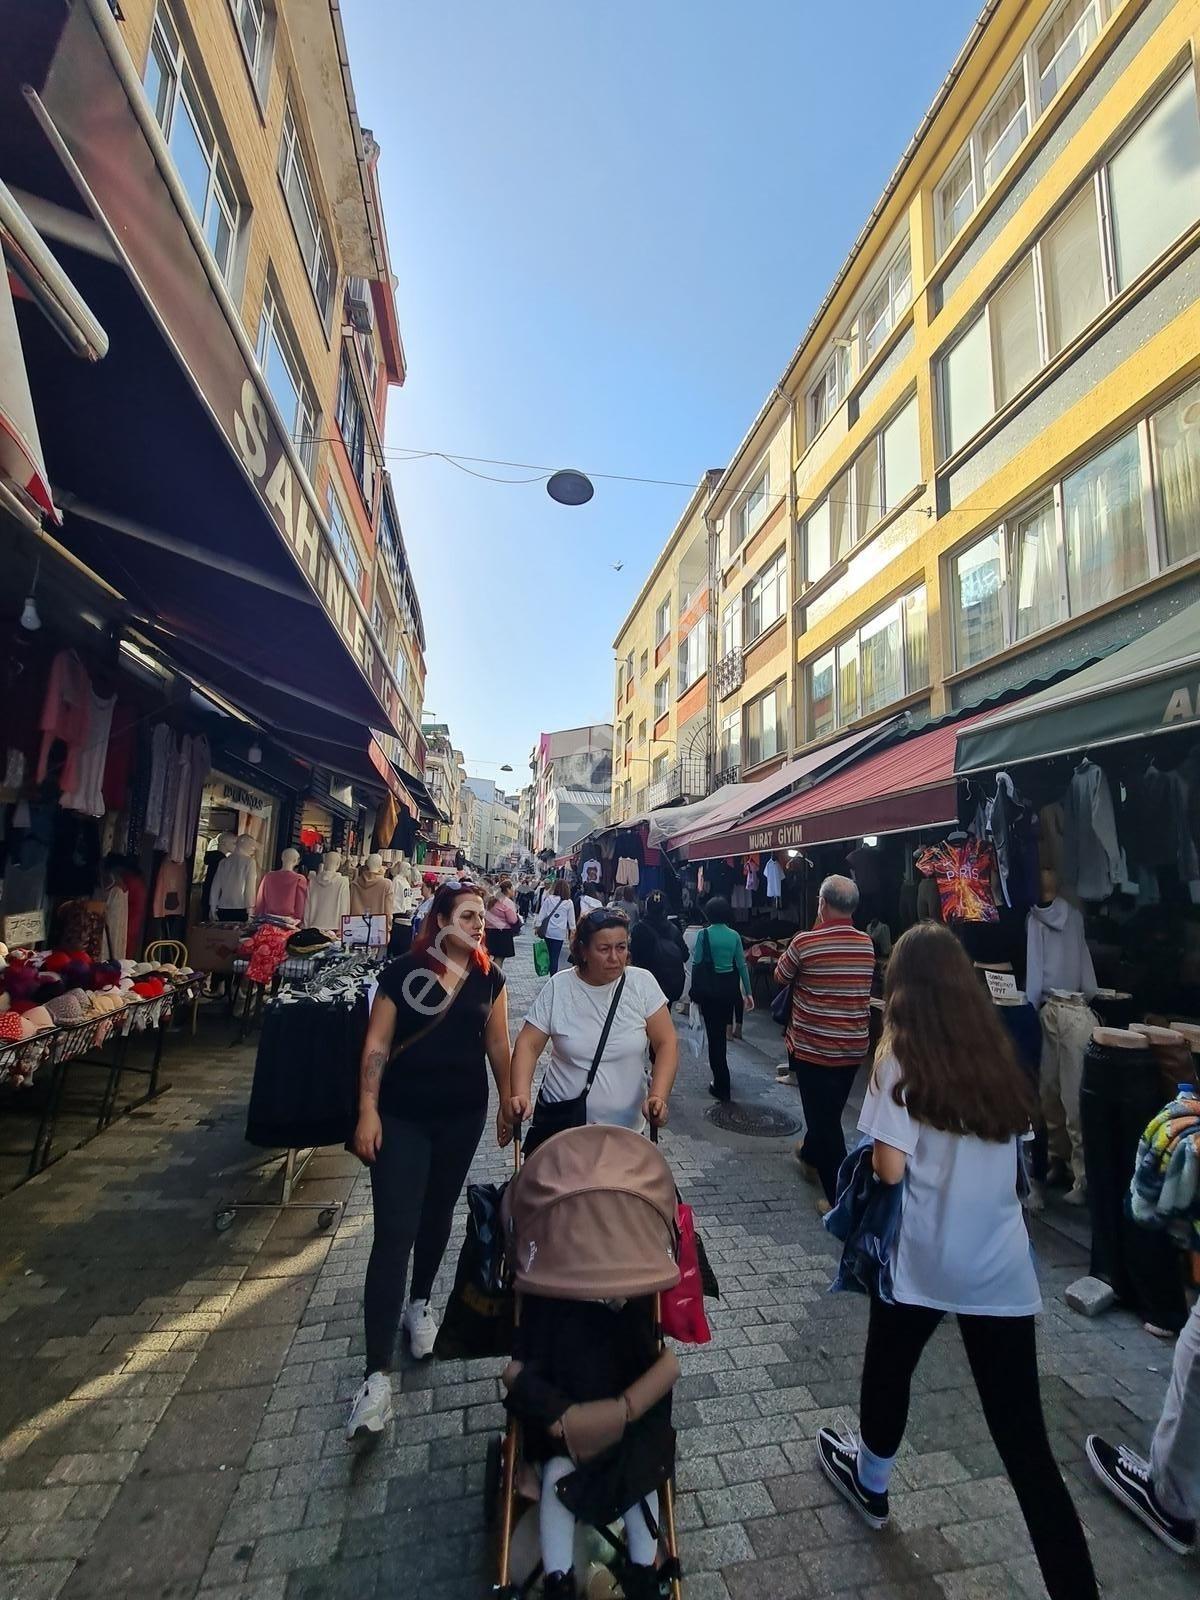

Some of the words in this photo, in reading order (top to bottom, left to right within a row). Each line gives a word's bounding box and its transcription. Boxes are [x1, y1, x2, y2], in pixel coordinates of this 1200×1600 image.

[1162, 683, 1200, 724] A
[749, 831, 773, 850] MURAT
[778, 824, 802, 844] GİYİM
